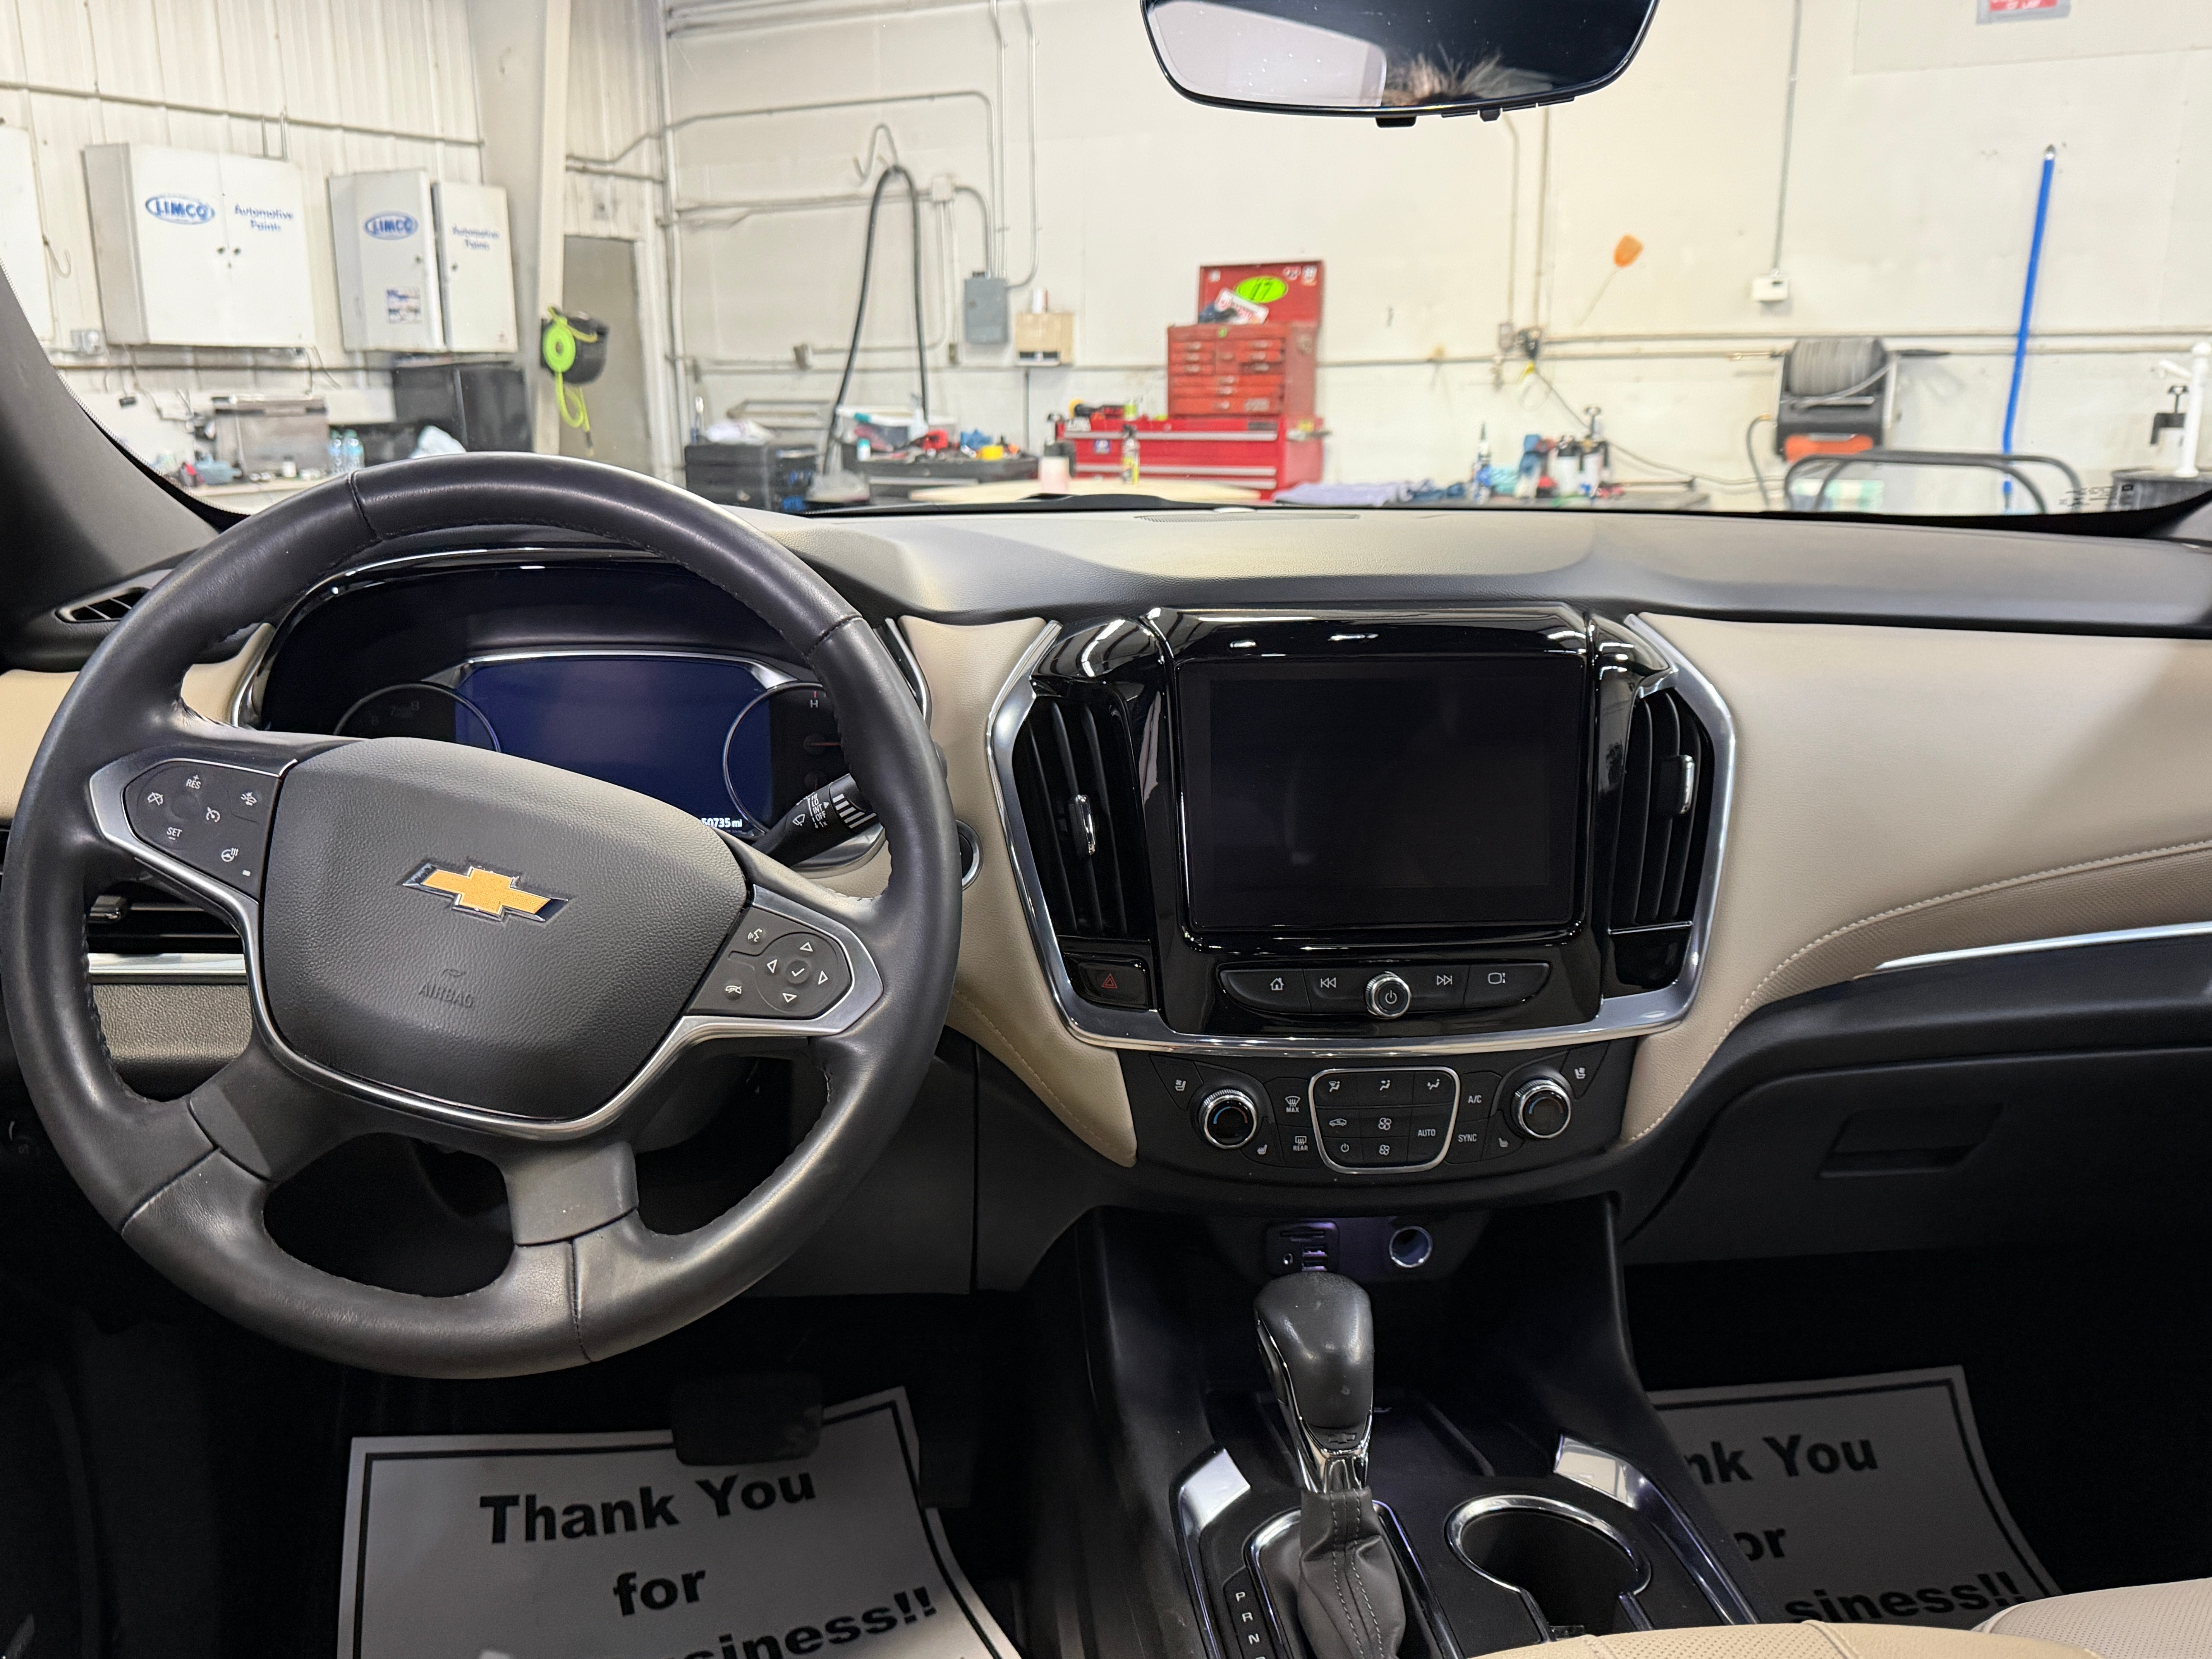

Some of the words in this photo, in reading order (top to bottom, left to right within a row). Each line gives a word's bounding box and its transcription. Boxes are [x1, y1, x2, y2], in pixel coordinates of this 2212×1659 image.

[156, 199, 209, 220] LIMCO
[235, 204, 294, 220] Automotive
[372, 216, 414, 235] LIMCO
[810, 700, 819, 708] H
[186, 779, 201, 789] RES
[811, 798, 819, 807] LO
[813, 804, 822, 815] INT
[815, 811, 826, 821] OFF
[732, 819, 742, 827] mi
[167, 827, 182, 837] SET
[418, 983, 474, 1007] AIRBAG
[1468, 1095, 1482, 1103] A/C
[1418, 1129, 1436, 1137] AUTO
[1458, 1134, 1477, 1142] SYNC
[1762, 1434, 1879, 1476] You
[480, 1486, 680, 1544] Thank
[695, 1472, 816, 1518] You
[613, 1570, 706, 1616] for
[1235, 1591, 1246, 1601] P
[1784, 1571, 2025, 1623] siness!!
[1242, 1612, 1253, 1622] R
[1248, 1633, 1260, 1645] N
